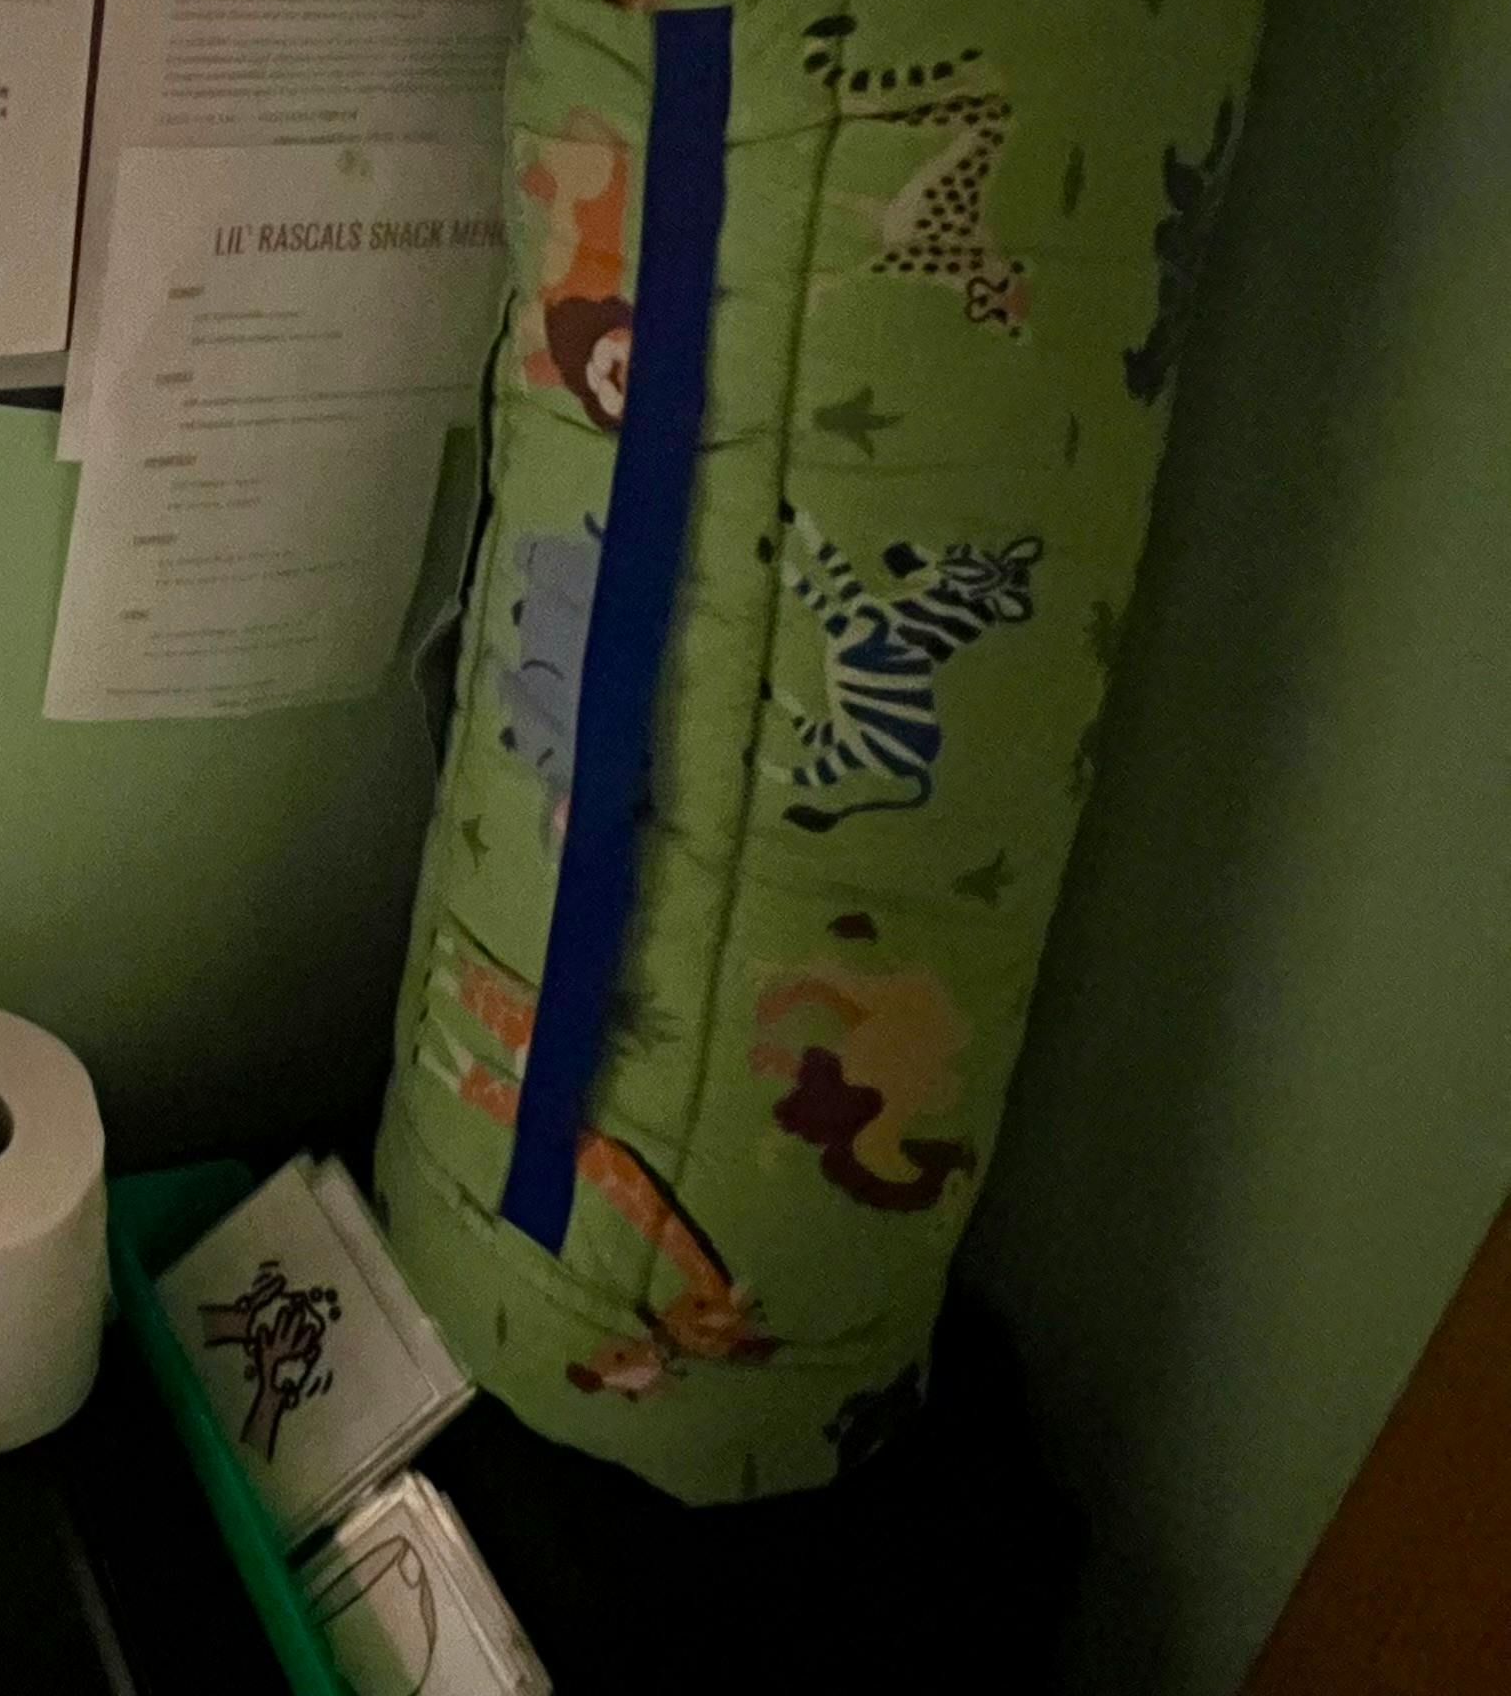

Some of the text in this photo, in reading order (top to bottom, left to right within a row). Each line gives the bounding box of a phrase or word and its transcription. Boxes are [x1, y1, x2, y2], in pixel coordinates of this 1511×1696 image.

[213, 225, 255, 257] LIL'
[256, 219, 362, 254] RASCALS
[368, 219, 446, 252] SNACK
